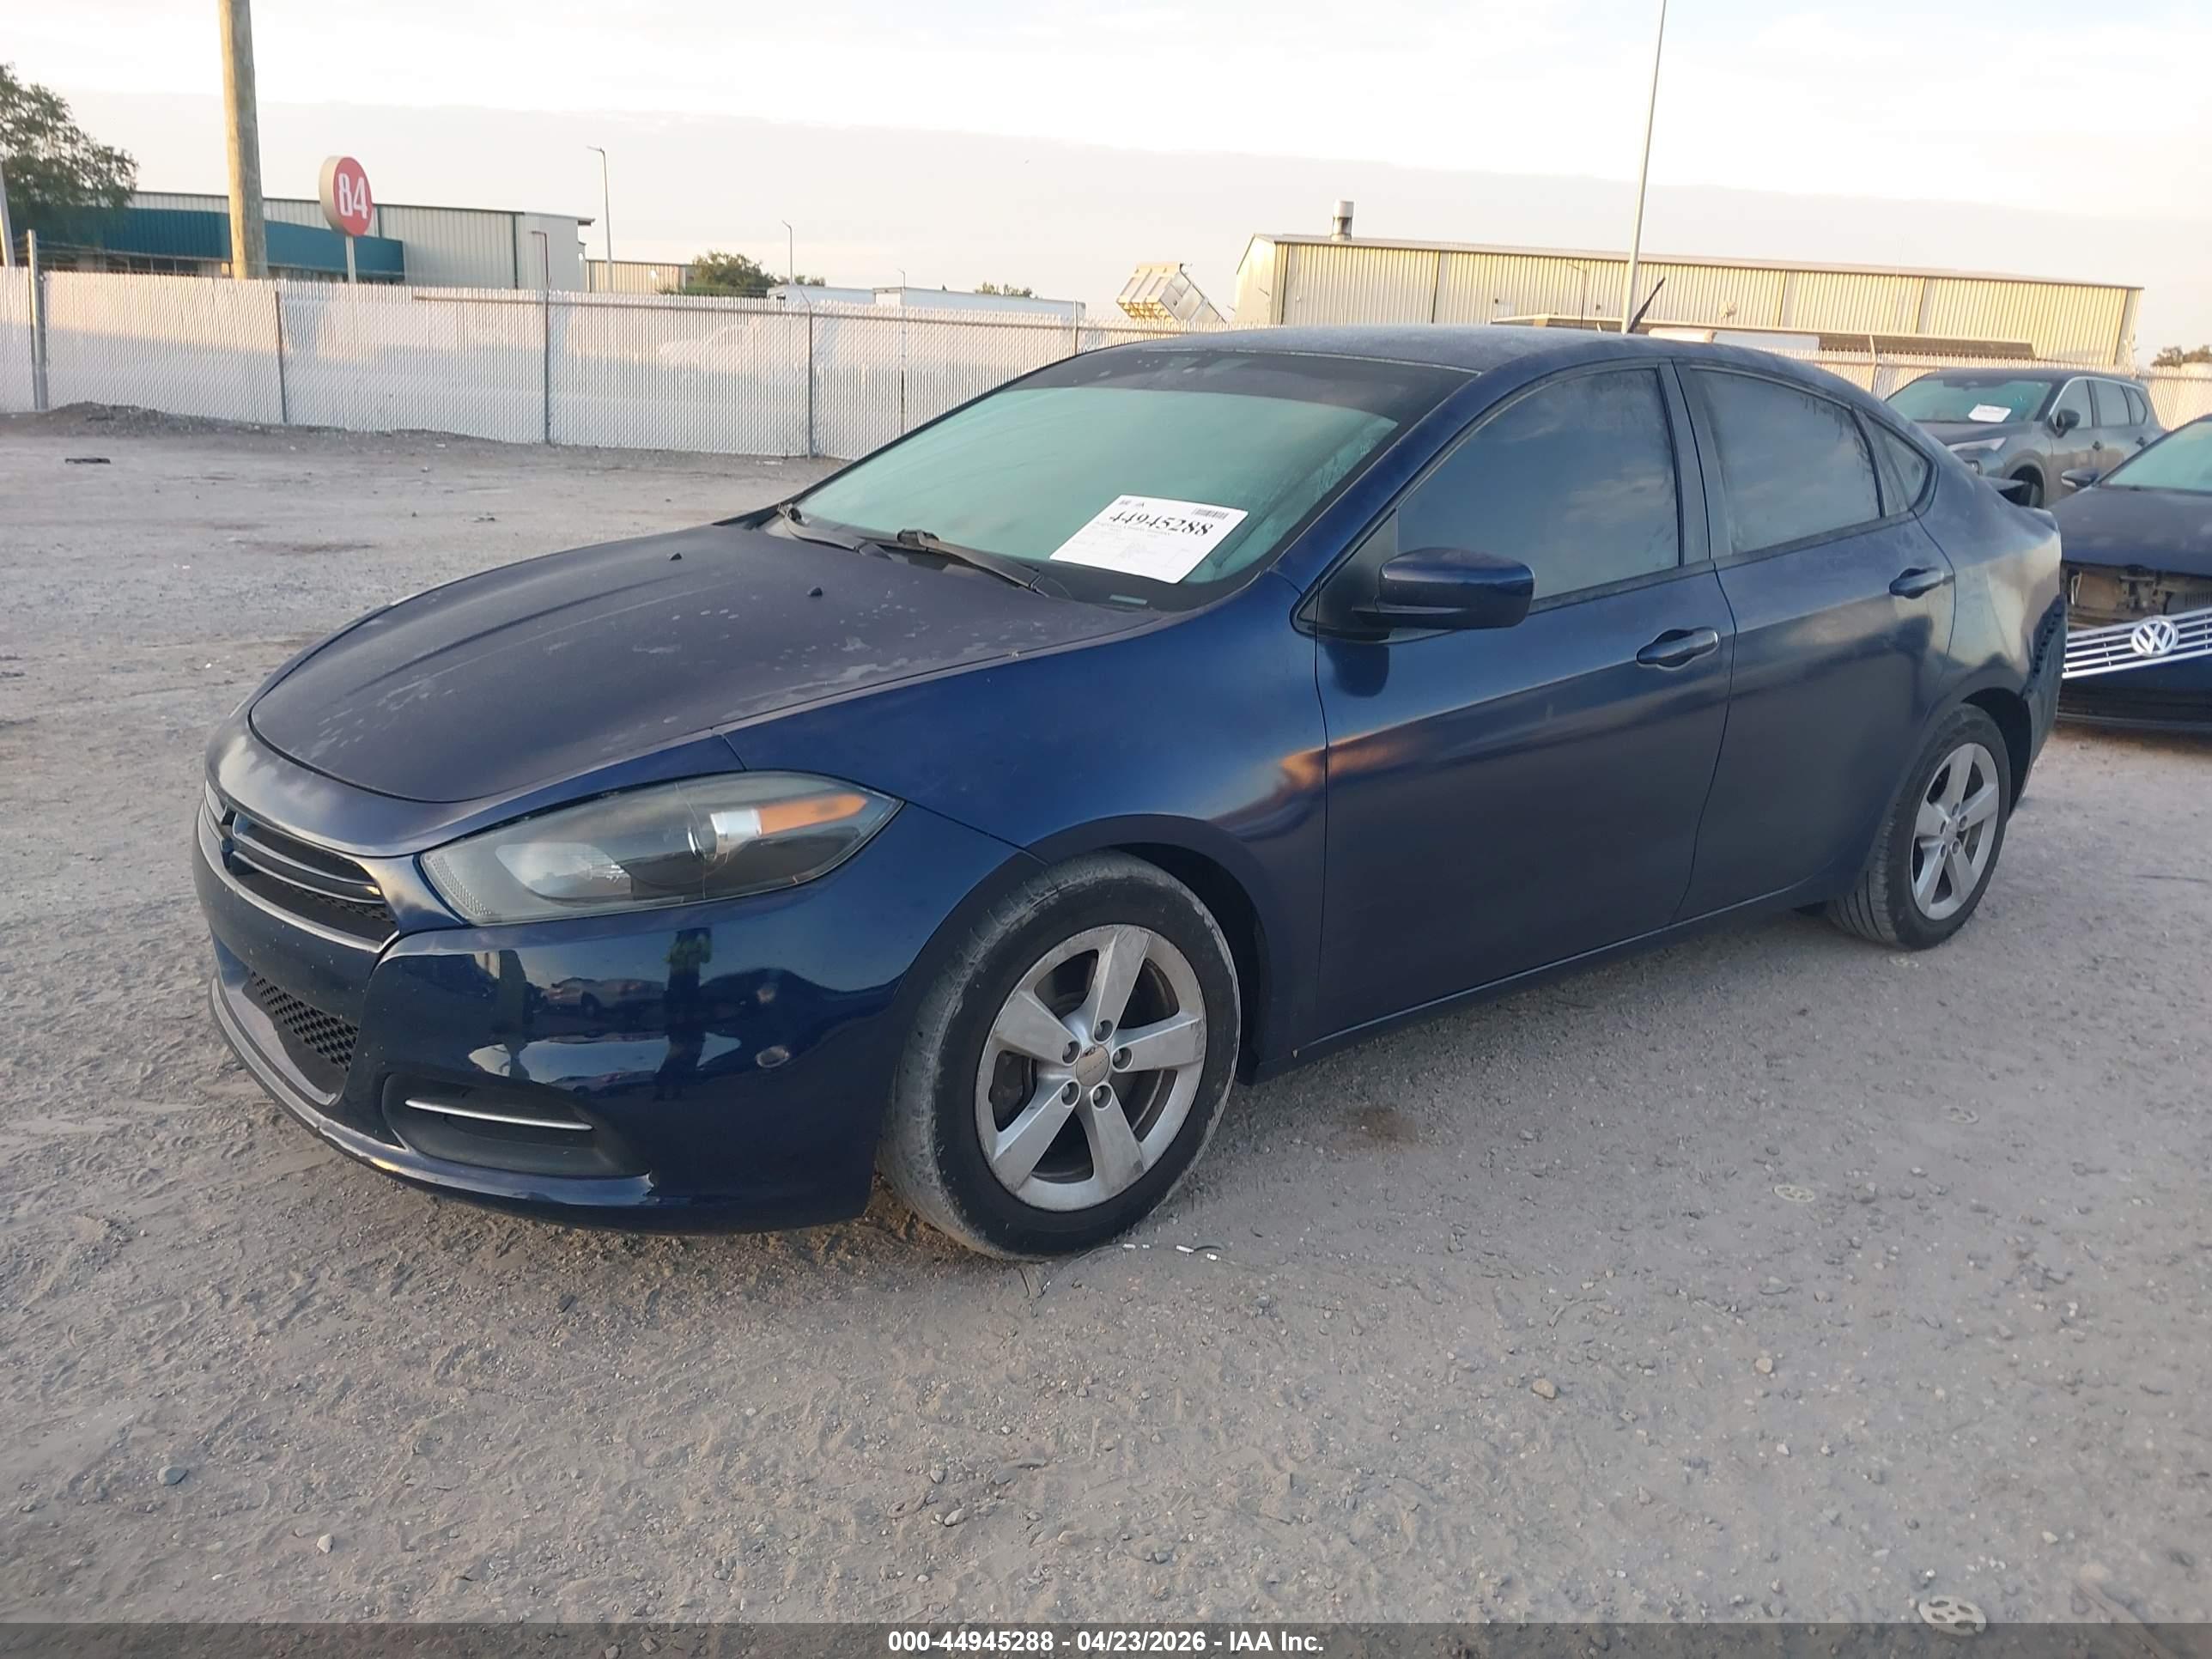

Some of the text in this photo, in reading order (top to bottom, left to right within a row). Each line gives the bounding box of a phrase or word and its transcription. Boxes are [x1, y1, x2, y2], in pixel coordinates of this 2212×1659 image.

[338, 173, 368, 219] 84
[1109, 510, 1214, 537] 44945288
[2133, 617, 2178, 657] VW
